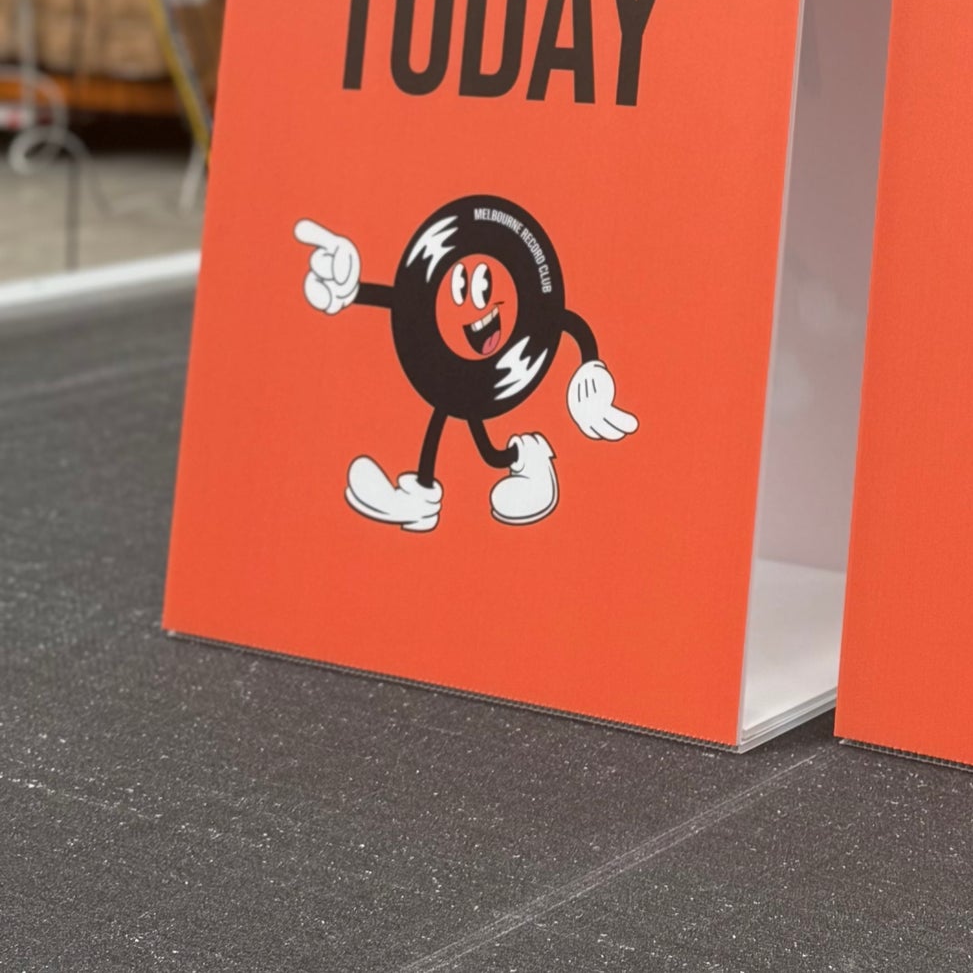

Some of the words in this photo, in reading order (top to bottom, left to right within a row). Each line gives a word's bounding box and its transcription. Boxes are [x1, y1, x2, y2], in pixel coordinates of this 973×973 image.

[474, 208, 524, 235] MELBOURNE
[520, 228, 546, 265] RECORD
[538, 264, 552, 294] CLUB
